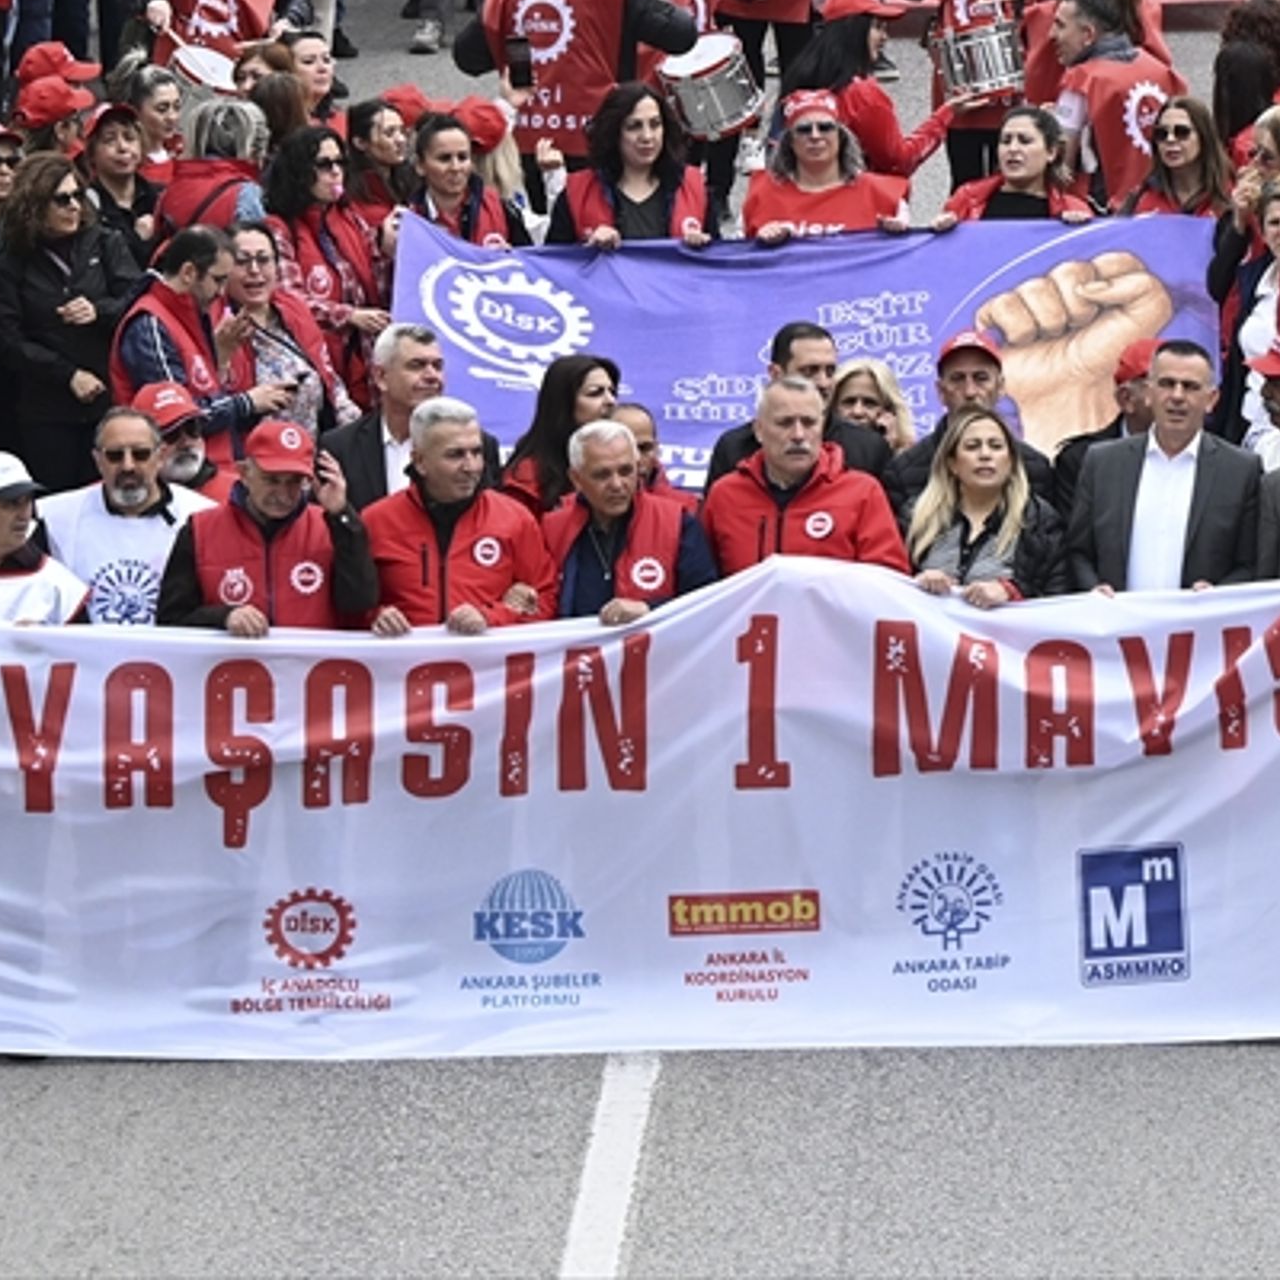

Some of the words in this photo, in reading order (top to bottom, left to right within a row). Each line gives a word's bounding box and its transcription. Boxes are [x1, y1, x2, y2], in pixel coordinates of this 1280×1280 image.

[480, 297, 560, 335] DİSK
[817, 290, 930, 327] EŞİT
[0, 632, 651, 848] YAŞASIN
[735, 614, 791, 789] 1
[671, 894, 816, 928] tmmob
[284, 910, 336, 935] DİSK
[473, 909, 586, 941] KESK
[706, 951, 769, 967] ANKARA
[772, 948, 787, 964] İL
[893, 957, 961, 975] ANKARA
[964, 954, 1011, 973] TABİP
[684, 967, 809, 986] KOORDİNASYON
[1085, 958, 1184, 982] ASMMMO
[281, 977, 360, 992] ANADOLU
[460, 975, 528, 990] ANKARA
[531, 972, 602, 992] ŞUBELER
[927, 976, 977, 993] ODASI
[231, 998, 283, 1014] BÖLGE
[288, 992, 391, 1011] TEMSİLCİLİĞİ
[482, 994, 580, 1008] PLATFORMU
[716, 988, 778, 1003] KURULU
